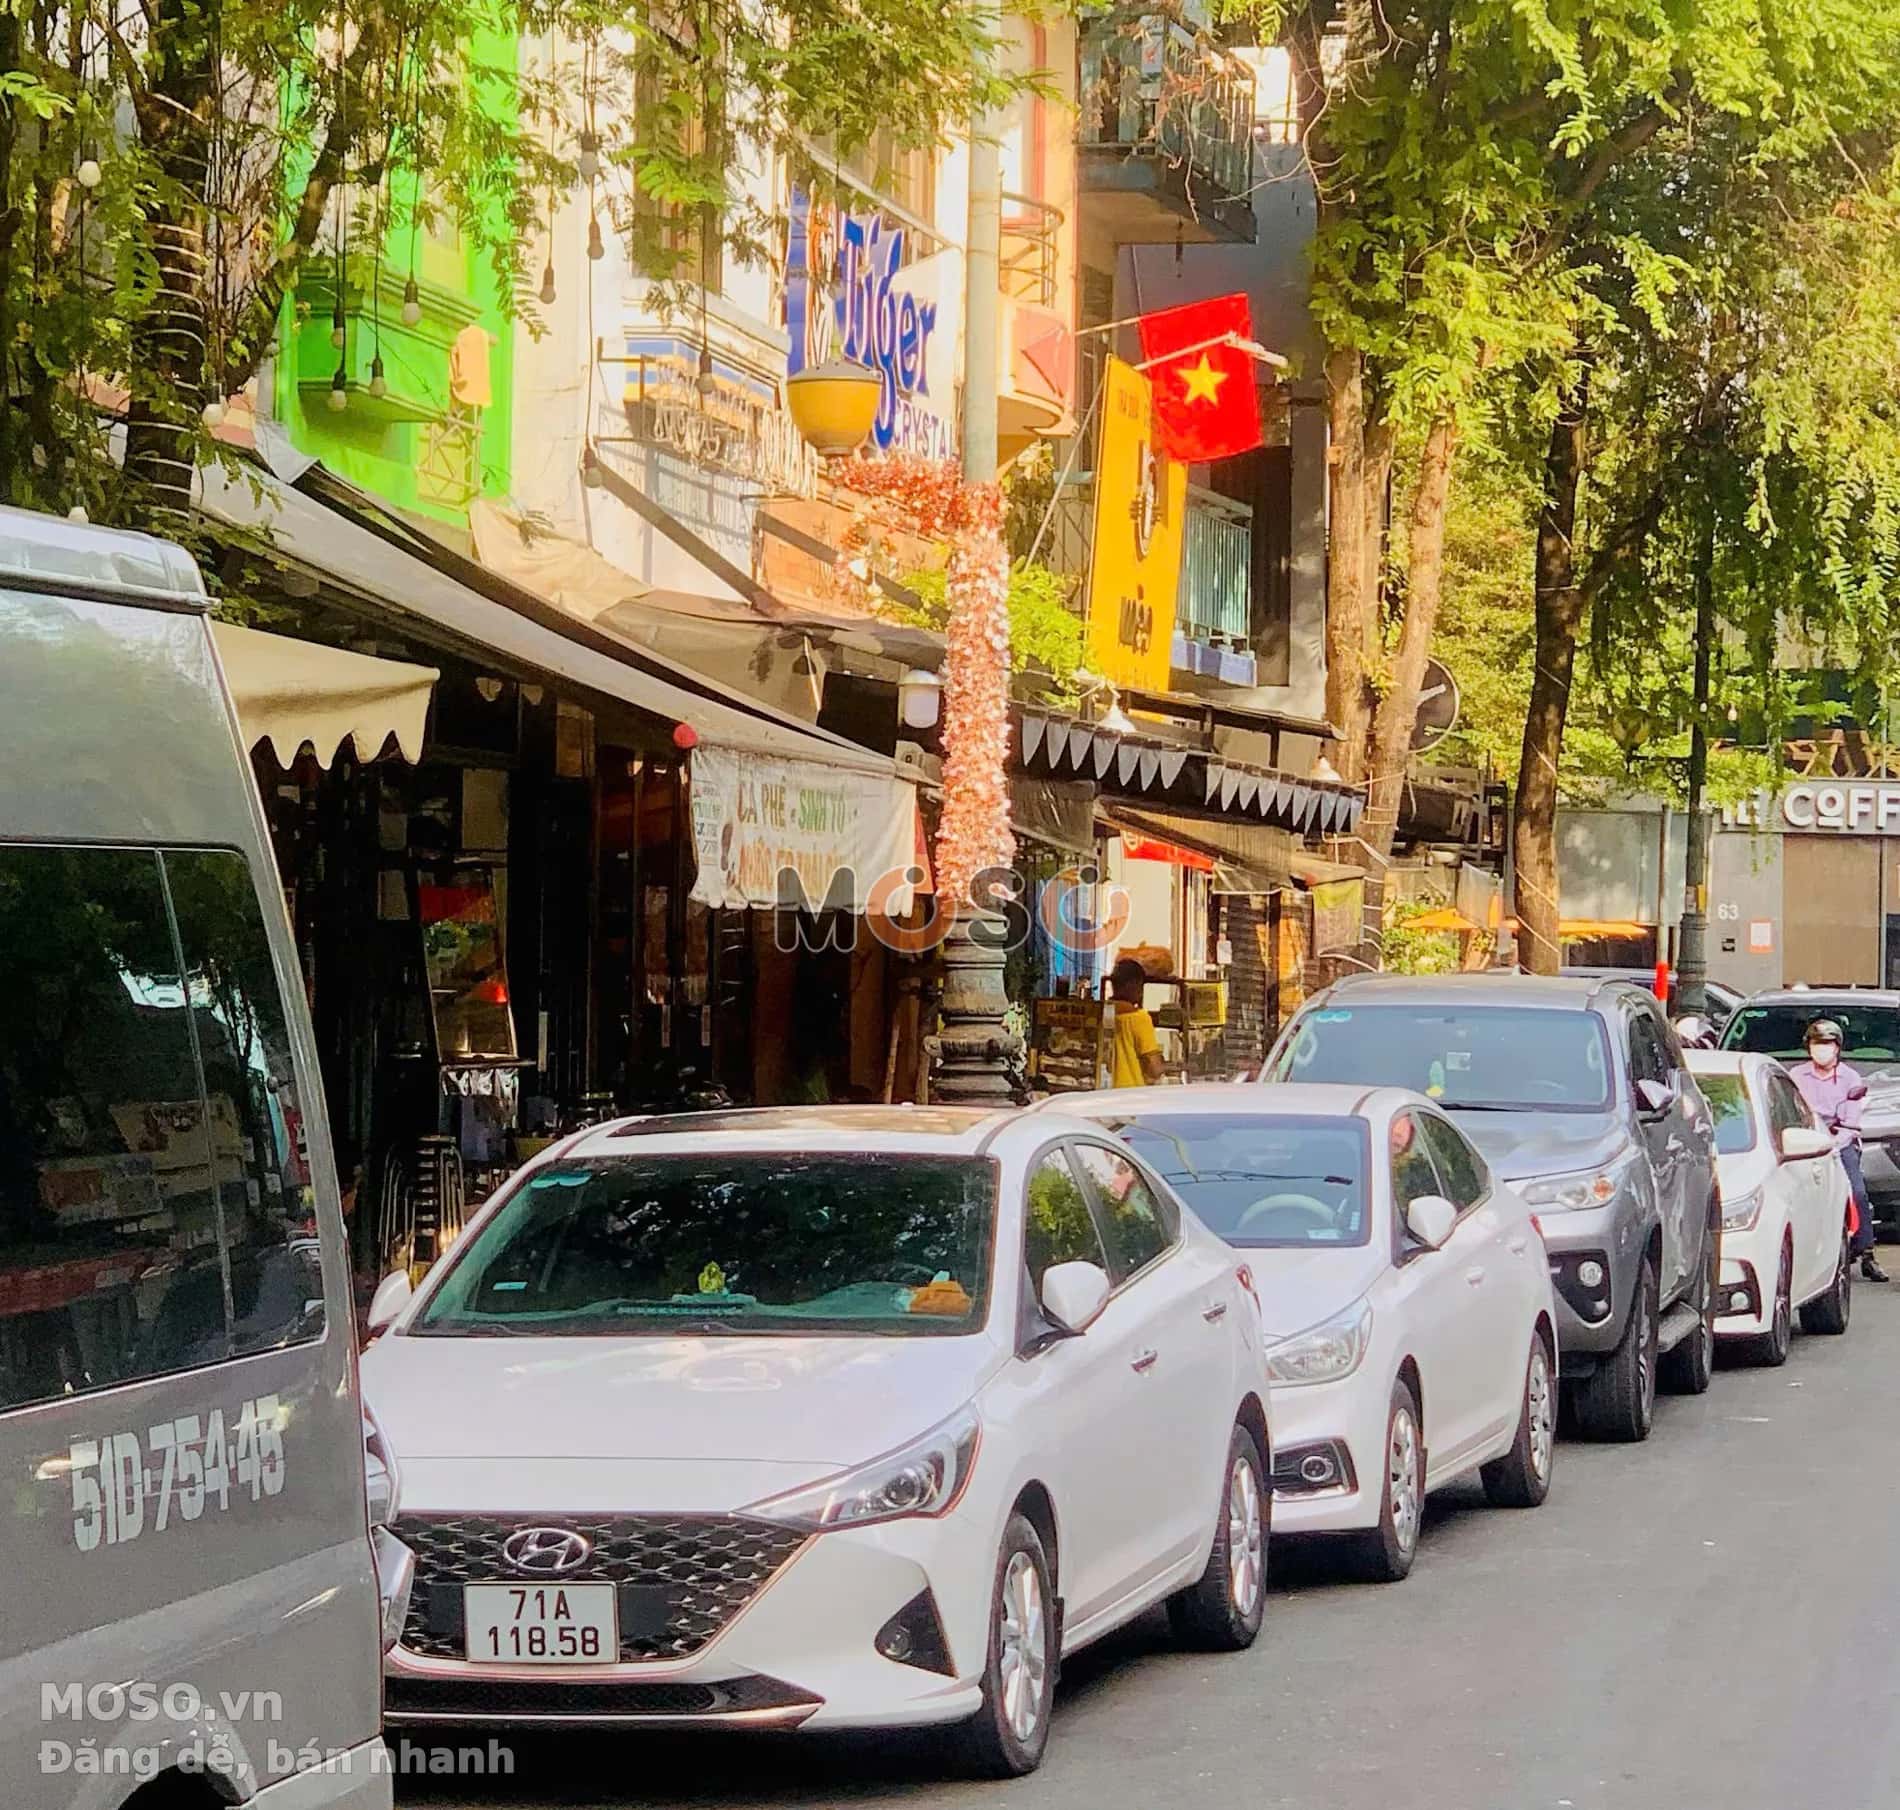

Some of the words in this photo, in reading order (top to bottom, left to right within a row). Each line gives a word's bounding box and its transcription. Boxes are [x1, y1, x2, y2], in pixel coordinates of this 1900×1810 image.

[841, 213, 937, 450] Tiger
[1718, 903, 1738, 920] 63
[509, 1589, 571, 1620] 71A
[488, 1625, 600, 1657] 118.58
